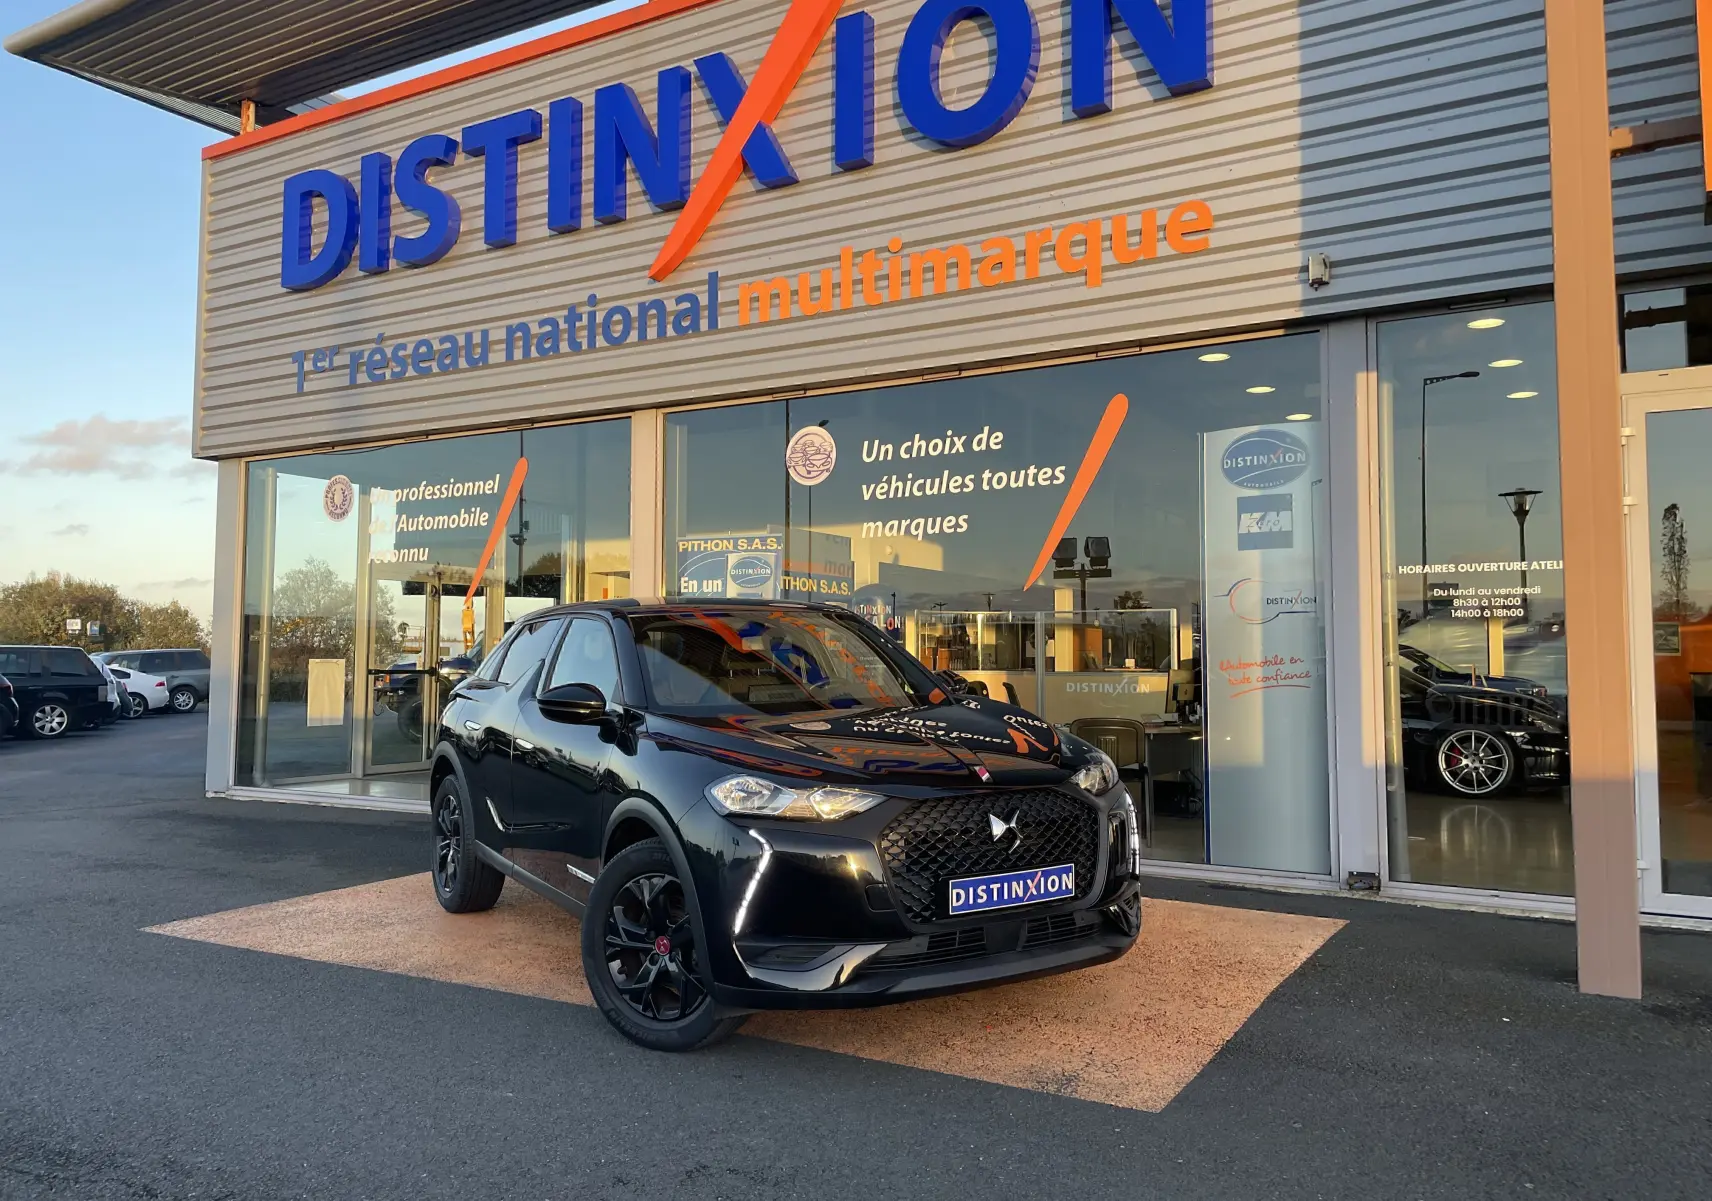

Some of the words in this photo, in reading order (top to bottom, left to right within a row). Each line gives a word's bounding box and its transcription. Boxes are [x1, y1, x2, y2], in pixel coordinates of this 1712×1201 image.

[281, 0, 1215, 291] DISTINXION
[291, 344, 339, 393] 1er
[349, 332, 489, 385] réseau
[505, 270, 719, 362] national
[738, 200, 1214, 326] multimarque
[862, 439, 893, 463] Un
[900, 430, 967, 459] choix
[972, 425, 1004, 451] de
[1223, 448, 1306, 469] DISTINXION
[393, 474, 500, 506] professionnel
[862, 469, 975, 501] véhicules
[982, 464, 1066, 491] toutes
[862, 514, 969, 541] marques
[679, 540, 734, 552] PITHON
[737, 538, 782, 550] S.A.S.
[1398, 564, 1456, 574] HORAIRES
[1457, 561, 1528, 572] OUVERTURE
[680, 577, 698, 592] En
[702, 579, 722, 593] un
[820, 579, 851, 596] S.A.S.
[1433, 588, 1448, 597] Du
[1449, 587, 1475, 596] lundi
[1493, 585, 1541, 595] vendredi
[1266, 590, 1317, 609] DISTINXION
[1452, 598, 1479, 607] 8h30
[1482, 597, 1489, 606] à
[1491, 597, 1521, 606] 12h00
[1450, 609, 1481, 618] 14h00
[1483, 608, 1490, 617] à
[1493, 608, 1524, 617] 18h00
[1256, 669, 1312, 684] confiance
[1066, 677, 1150, 697] DISTINXION
[952, 871, 1073, 907] DISTINXION
